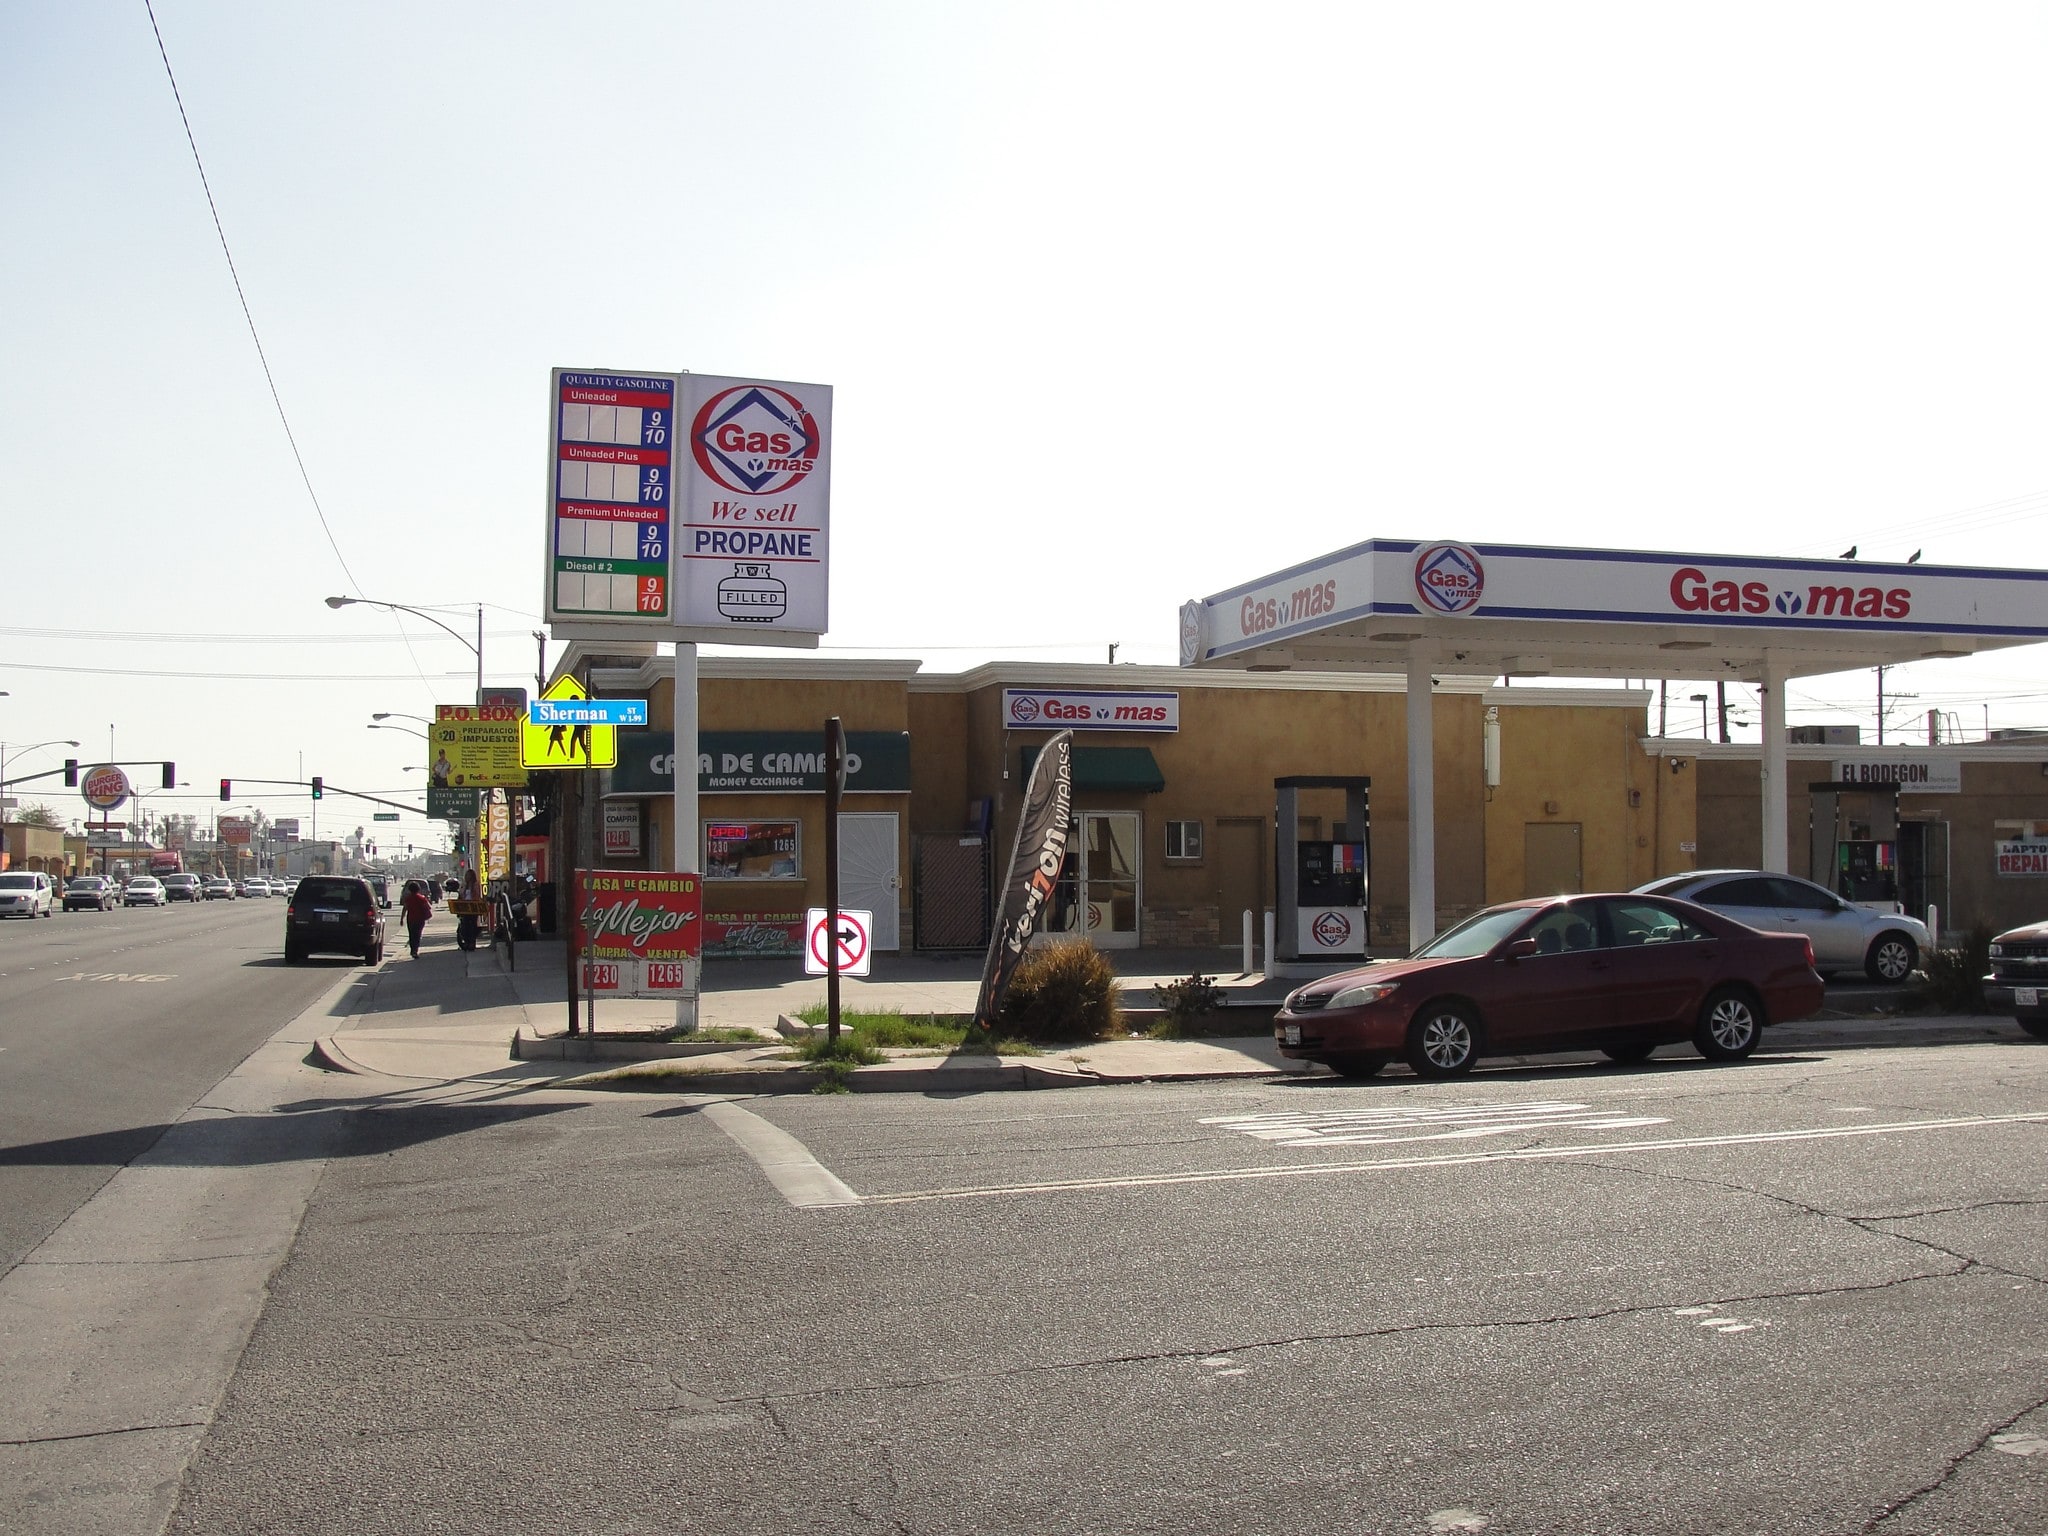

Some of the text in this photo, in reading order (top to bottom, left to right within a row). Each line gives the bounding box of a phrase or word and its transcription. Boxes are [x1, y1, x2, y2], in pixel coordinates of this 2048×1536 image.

[566, 375, 669, 390] QUALITY GASOLINE
[571, 391, 617, 402] Unleaded
[651, 411, 661, 426] 9
[645, 429, 665, 444] 10
[716, 423, 791, 454] Gas
[569, 449, 639, 461] Unleaded Plus
[766, 457, 814, 472] mas
[650, 468, 660, 483] 9
[643, 486, 663, 501] 10
[567, 506, 658, 519] Premium Unleaded
[711, 501, 797, 522] We sell
[647, 525, 658, 540] 9
[642, 543, 661, 558] 10
[695, 530, 812, 556] PROPANE
[566, 561, 613, 572] Diesel # 2
[646, 577, 657, 592] 9
[1427, 569, 1470, 588] Gas
[727, 592, 778, 603] FILLED
[1456, 588, 1482, 599] mas
[1670, 567, 1769, 614] Gas
[1806, 585, 1912, 619] mas
[641, 595, 661, 611] 10
[1240, 595, 1276, 636] Gas
[1291, 579, 1336, 622] mas
[438, 705, 519, 722] P.O. BOX
[540, 706, 637, 721] Sherman ST
[1043, 699, 1092, 721] Gas
[1114, 705, 1167, 721] mas
[619, 714, 627, 722] W
[463, 735, 520, 743] IMPUESTOS
[650, 752, 862, 774] CAA DE CAMBO
[88, 773, 122, 789] BURGER
[1842, 764, 1928, 783] EL BODEGON
[709, 777, 804, 787] MONEY EXCHANGE
[1051, 742, 1070, 829] wireless
[88, 781, 123, 799] KING
[606, 815, 638, 823] COMPRA
[710, 827, 745, 837] OPEN
[708, 839, 795, 853] 1230 1265
[624, 880, 636, 888] DE
[638, 879, 695, 893] CAMBIO
[1008, 828, 1068, 954] verizon
[580, 896, 697, 947] La Mejor
[704, 913, 737, 921] CASA
[743, 913, 758, 921] DE
[725, 924, 788, 948] La Mejor
[1320, 924, 1343, 934] Gas
[646, 949, 688, 959] VENTA
[585, 964, 682, 984] 230 1265
